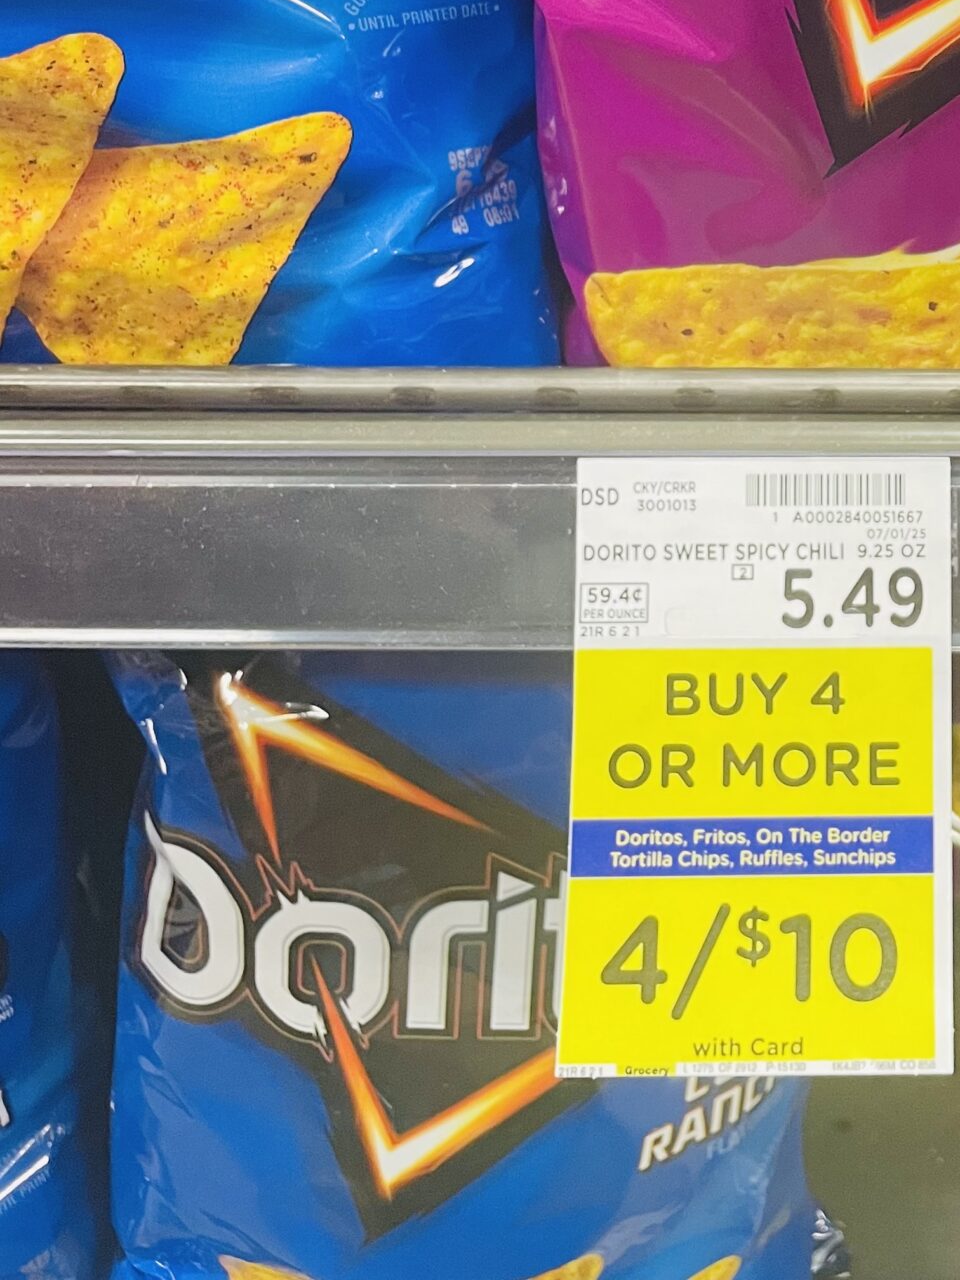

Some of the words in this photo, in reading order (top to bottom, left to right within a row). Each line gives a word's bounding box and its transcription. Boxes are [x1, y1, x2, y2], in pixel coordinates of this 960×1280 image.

[358, 14, 399, 32] UNTIL
[402, 6, 458, 25] PRINTED
[633, 481, 697, 495] CKY/CRKR
[581, 488, 619, 506] DSD
[637, 499, 697, 511] 3001013
[793, 511, 923, 523] A0002840051667
[867, 528, 926, 541] 07/01/25
[583, 544, 657, 561] DORITO
[663, 544, 729, 561] SWEET
[735, 543, 790, 560] SPICY
[796, 543, 844, 560] CHILI
[857, 544, 894, 558] 9.25
[901, 544, 926, 558] OZ
[739, 567, 748, 579] 2
[587, 587, 643, 604] 59.4¢
[782, 567, 924, 629] 5.49
[583, 608, 604, 619] PER
[607, 608, 646, 619] OUNCE
[580, 626, 604, 637] 21R
[608, 626, 617, 637] 6
[622, 626, 631, 637] 2
[665, 672, 788, 716] BUY
[810, 672, 846, 715] 4
[608, 743, 696, 789] OR
[722, 742, 901, 788] MORE
[615, 829, 688, 848] Doritos,
[693, 829, 750, 847] Fritos,
[756, 829, 783, 845] On
[789, 828, 822, 844] The
[827, 827, 891, 844] Border
[610, 850, 673, 868] Tortilla
[678, 850, 734, 870] Chips,
[739, 849, 808, 869] Ruffles,
[813, 848, 896, 870] Sunchips
[693, 1037, 741, 1056] with
[750, 1036, 805, 1057] Card
[625, 1065, 669, 1076] Grocery
